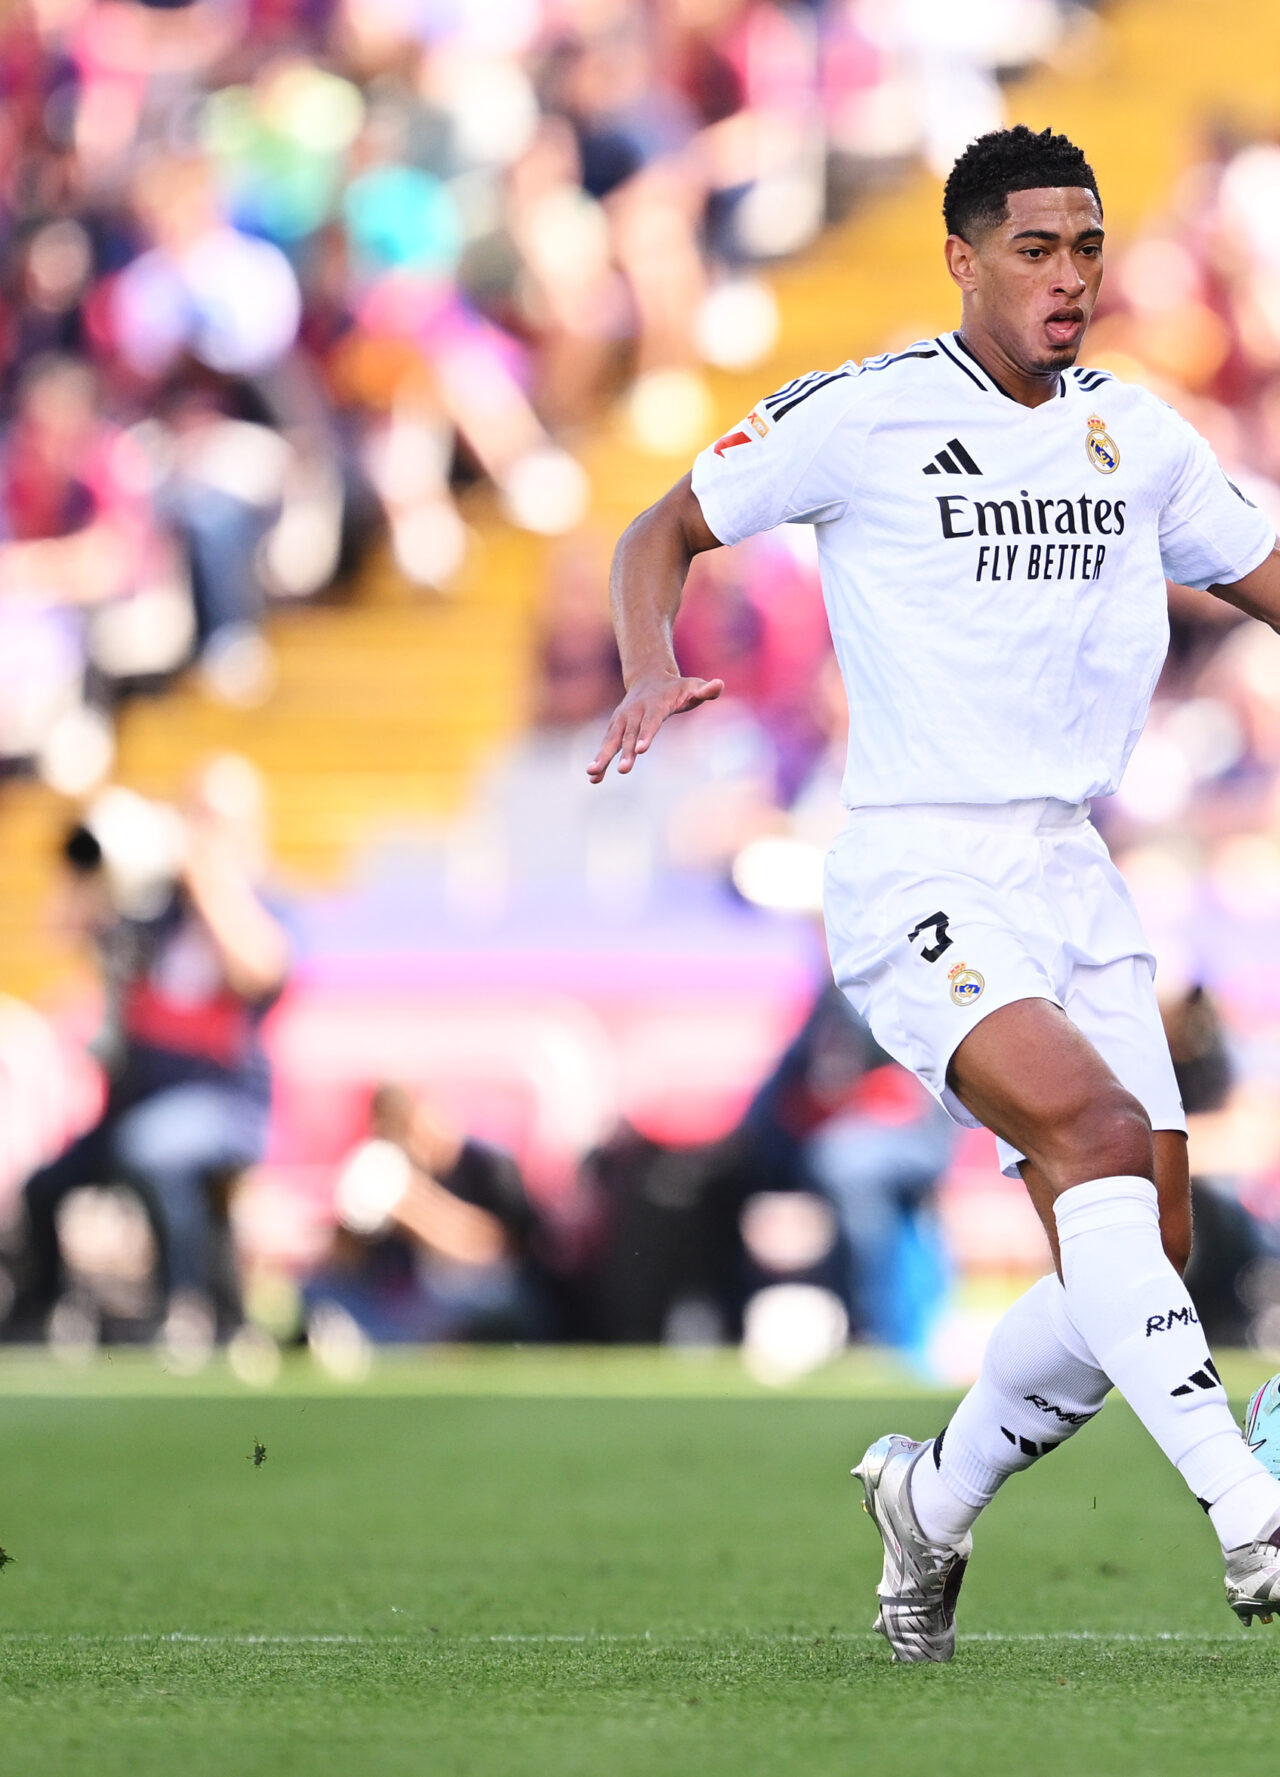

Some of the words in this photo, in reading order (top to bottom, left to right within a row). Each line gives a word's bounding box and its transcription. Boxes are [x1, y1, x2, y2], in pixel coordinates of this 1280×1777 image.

[934, 489, 1126, 539] Emirates
[976, 544, 1019, 582] FLY
[1027, 544, 1106, 581] BETTER
